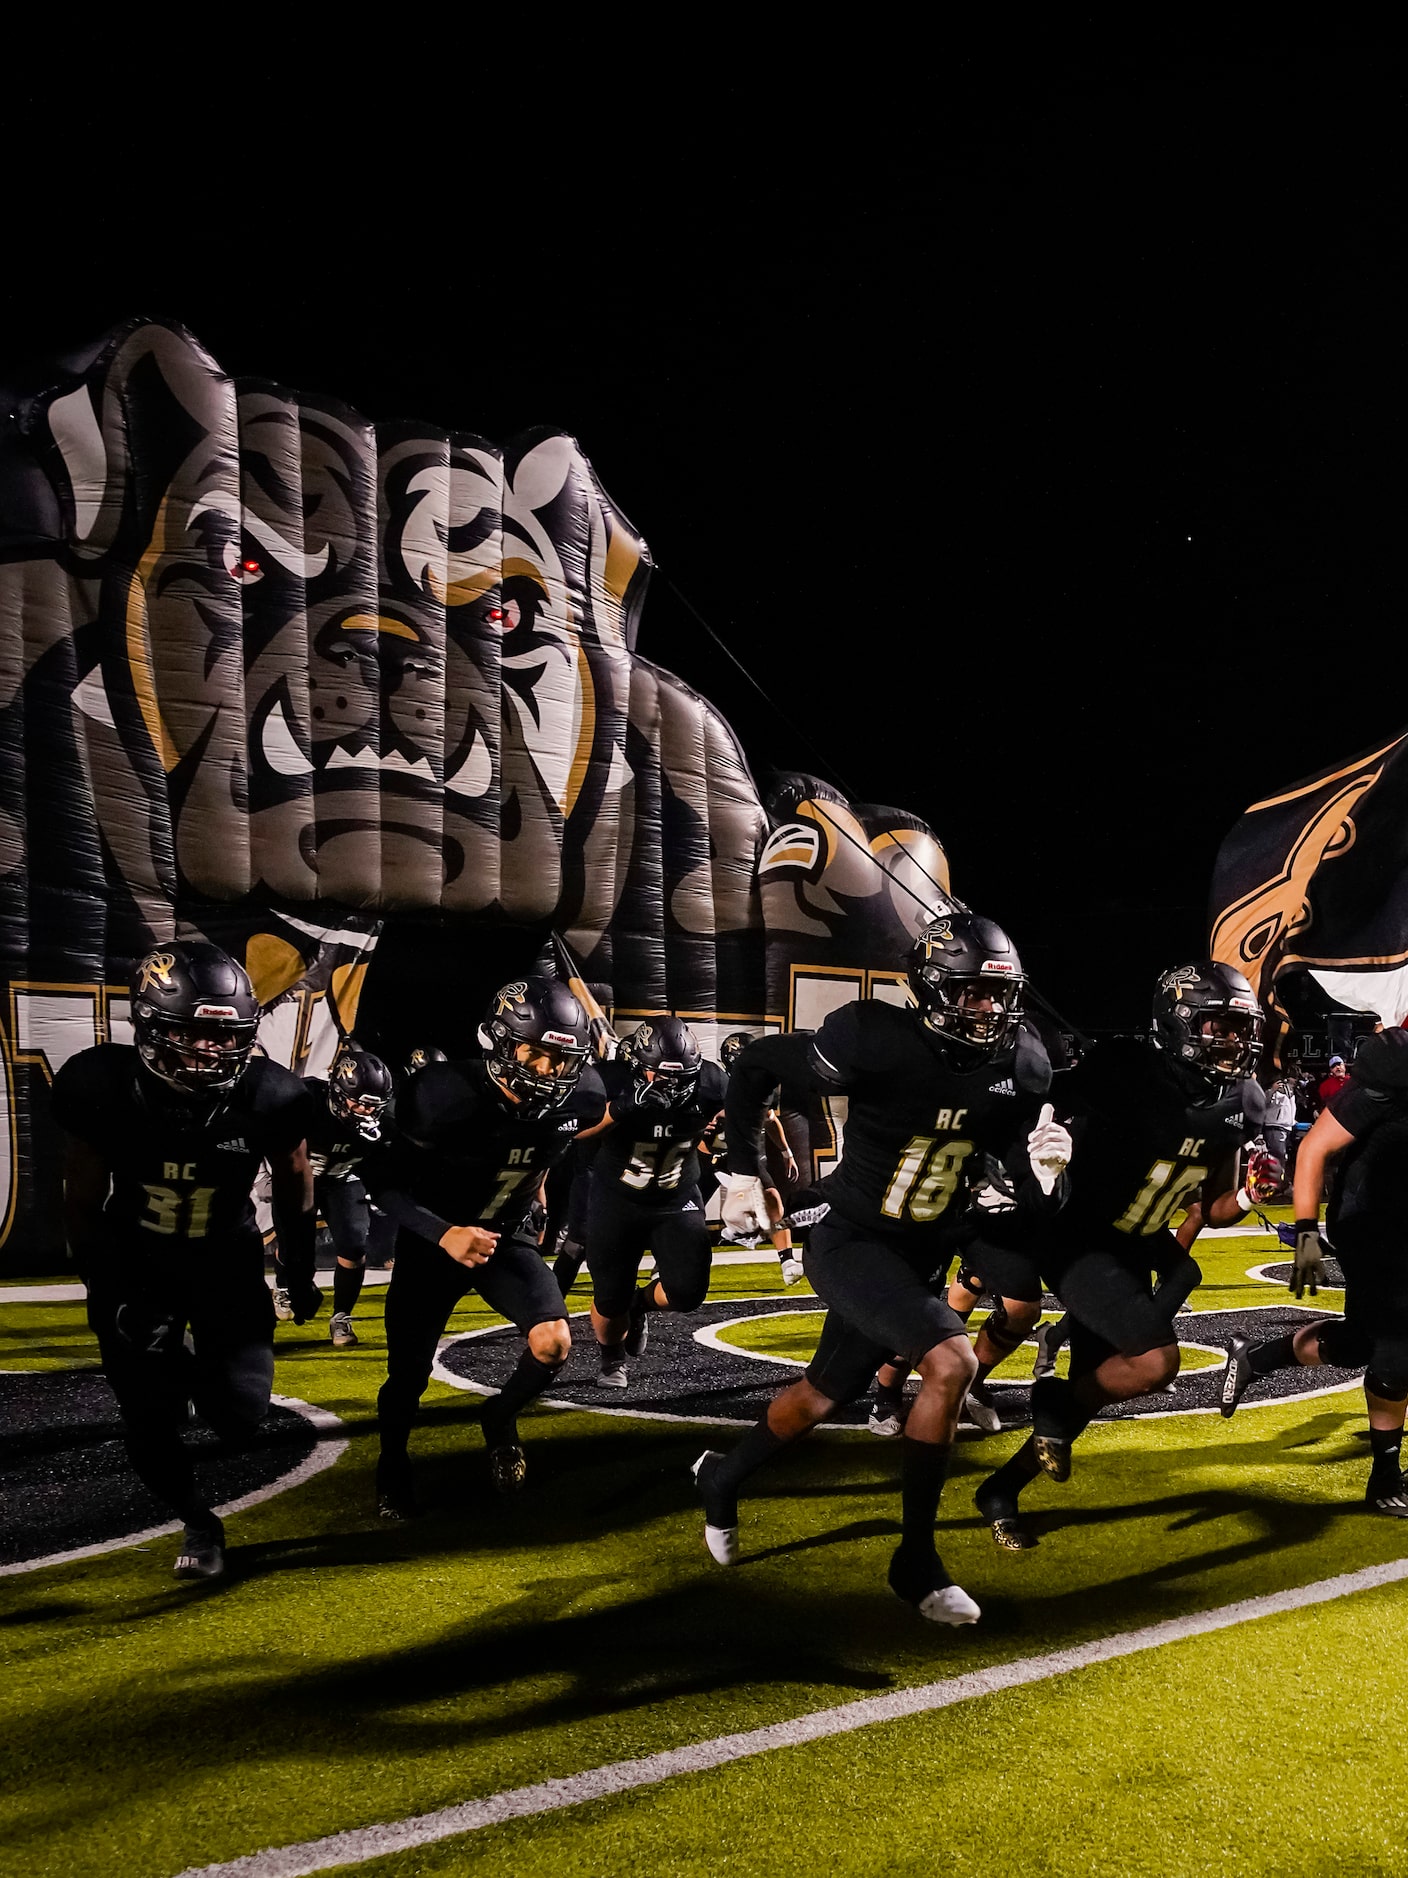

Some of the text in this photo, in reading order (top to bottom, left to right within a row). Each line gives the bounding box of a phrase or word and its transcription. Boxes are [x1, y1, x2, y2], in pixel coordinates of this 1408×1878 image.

[934, 1108, 969, 1131] RC
[653, 1125, 674, 1138] RC
[507, 1146, 536, 1165] RC
[1177, 1137, 1206, 1159] RC
[163, 1161, 197, 1181] RC
[880, 1135, 975, 1223] 18
[478, 1169, 529, 1220] 7
[138, 1183, 217, 1239] 31
